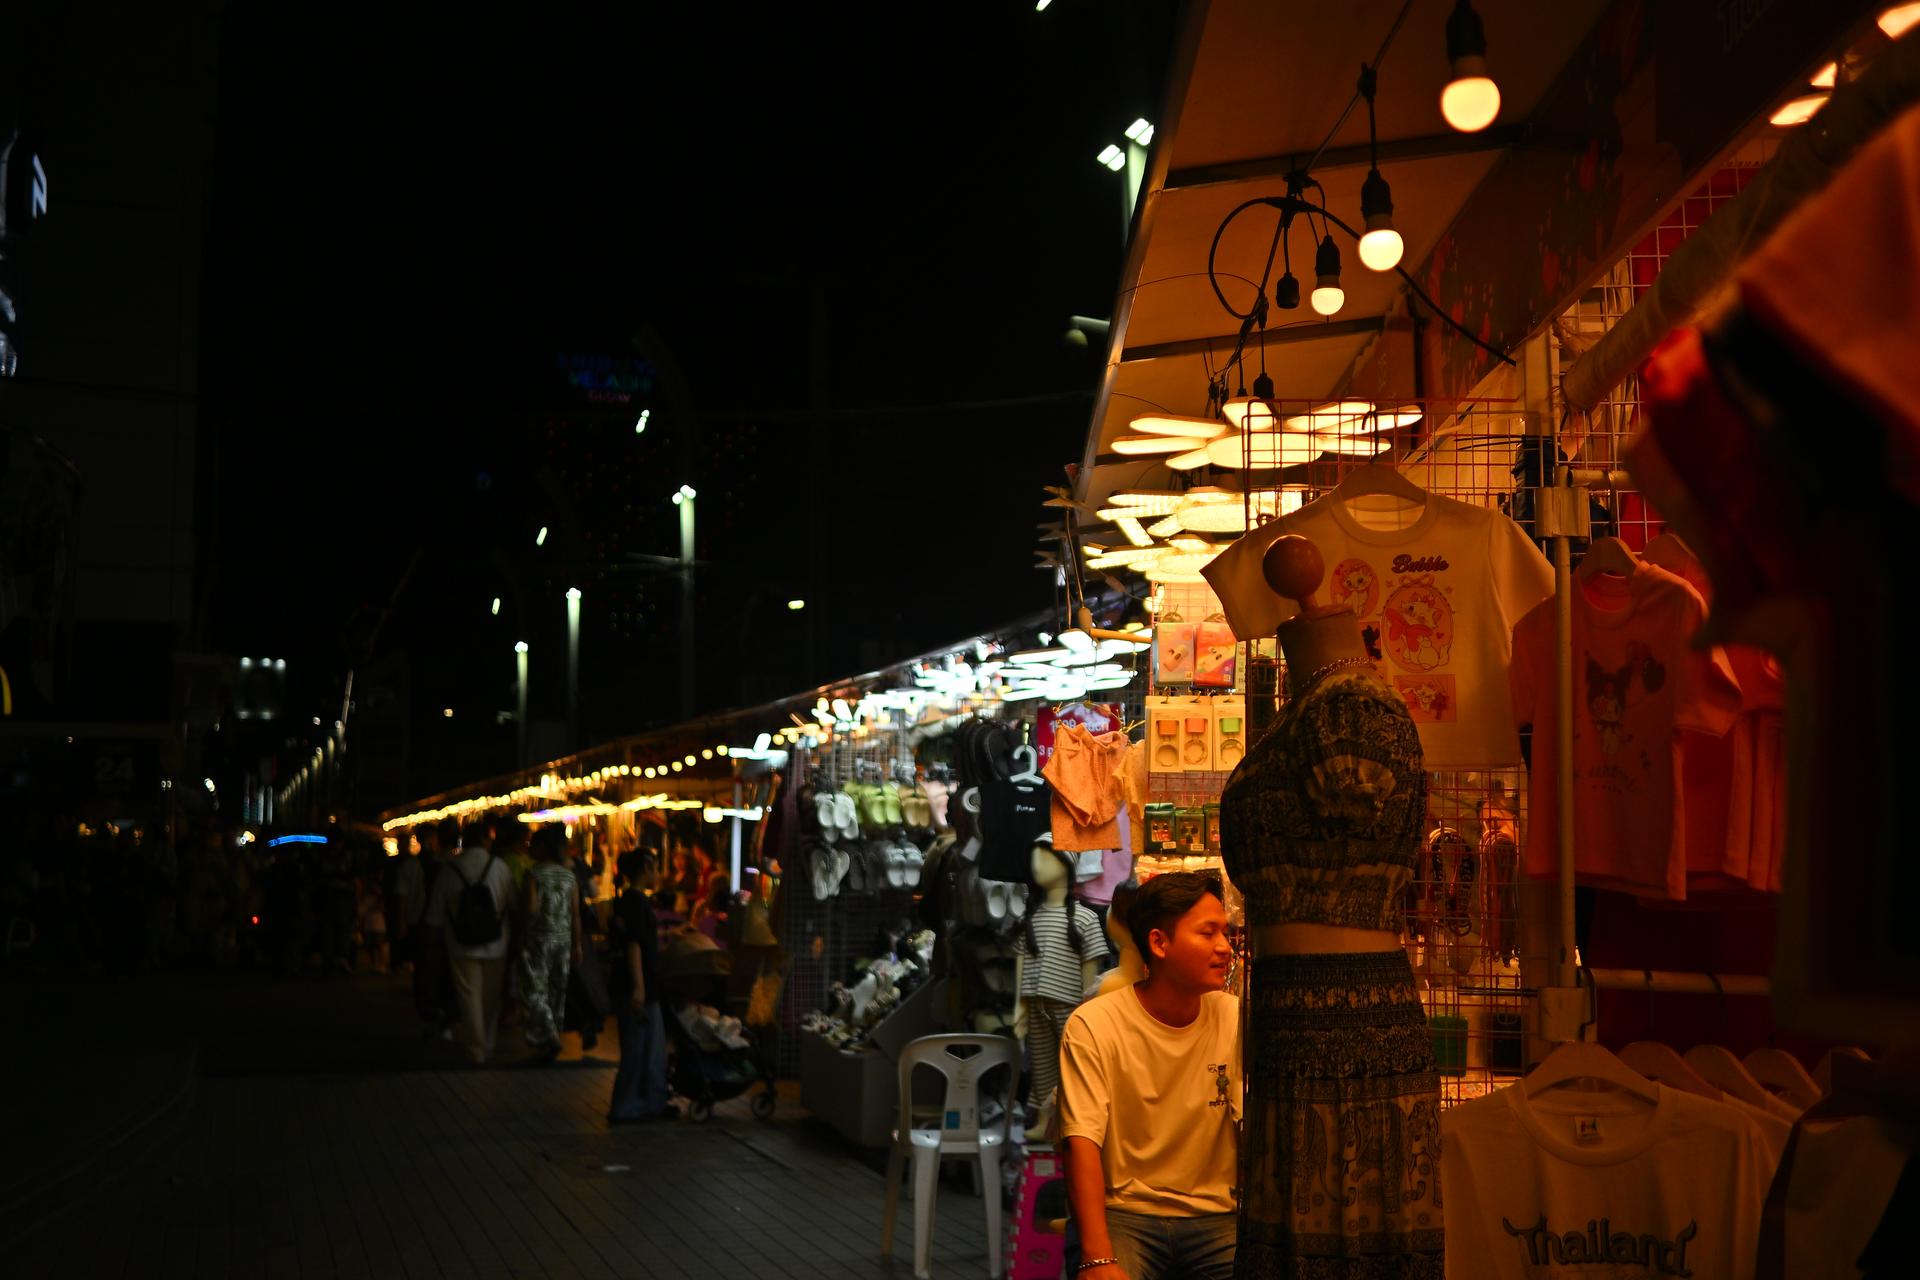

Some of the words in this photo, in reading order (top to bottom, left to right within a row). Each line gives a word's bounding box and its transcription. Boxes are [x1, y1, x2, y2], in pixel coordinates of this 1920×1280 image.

[1391, 553, 1450, 574] Bubble
[93, 756, 137, 781] 24
[1502, 1213, 1698, 1278] Thailand
